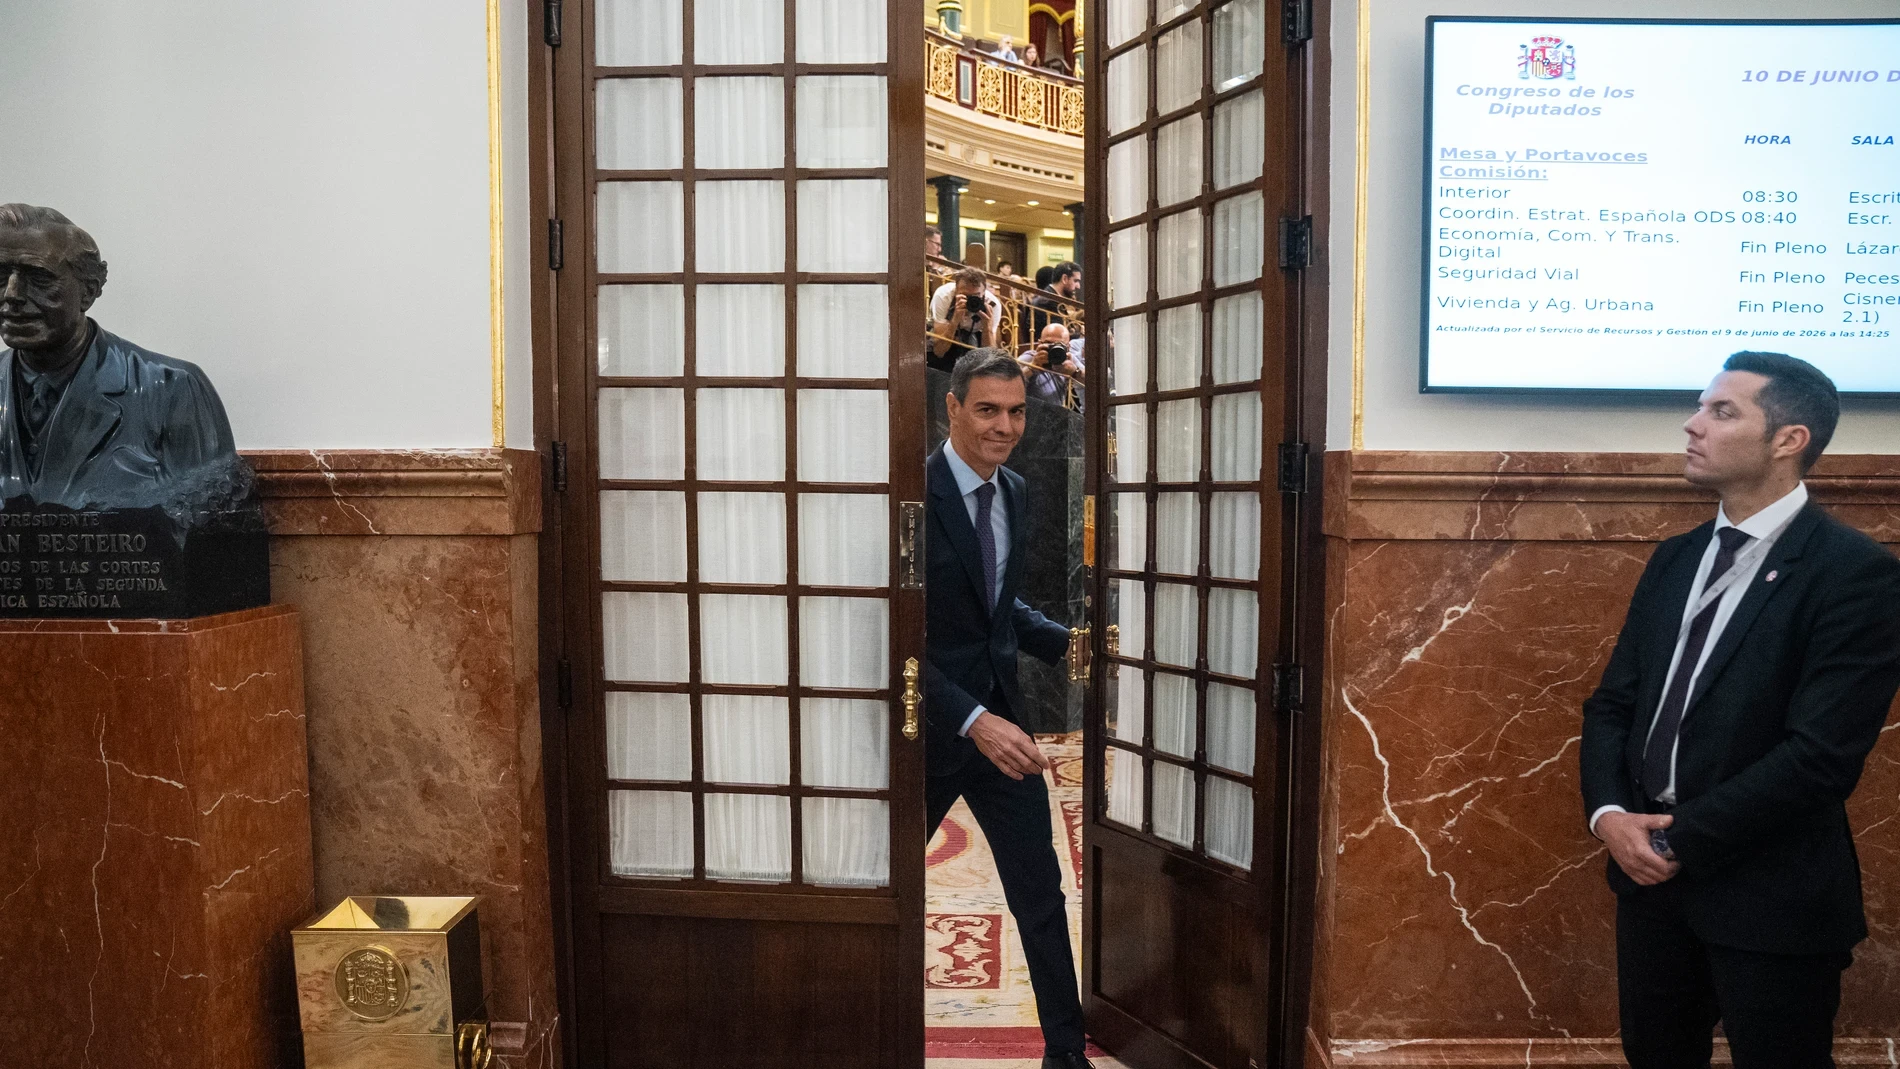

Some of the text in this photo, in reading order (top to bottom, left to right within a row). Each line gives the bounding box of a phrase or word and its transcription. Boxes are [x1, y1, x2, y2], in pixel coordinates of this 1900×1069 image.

[1742, 70, 1768, 82] 10
[1776, 71, 1806, 82] DE
[1810, 70, 1879, 85] JUNIO
[1455, 84, 1634, 100] Congreso de los
[1489, 103, 1602, 118] Diputados
[1745, 135, 1790, 144] HORA
[1852, 136, 1894, 145] SALA
[1439, 147, 1649, 163] Mesa y Portavoces
[1439, 165, 1548, 181] Comisión:
[1440, 186, 1510, 198] Interior
[1743, 191, 1797, 203] 08:30
[1439, 207, 1735, 224] Coordin. Estrat. Española ODS
[1742, 212, 1796, 224] 08:40
[1848, 213, 1891, 224] Escr.
[1439, 228, 1679, 243] Economía, Com. Y Trans.
[1439, 246, 1500, 261] Digital
[1741, 242, 1826, 254] Fin Pleno
[1846, 241, 1900, 254] Lázar
[1439, 267, 1578, 281] Seguridad Vial
[1740, 271, 1825, 283] Fin Pleno
[1845, 272, 1900, 284] Peces
[1437, 297, 1653, 313] Vivienda y Ag. Urbana
[1739, 301, 1823, 313] Fin Pleno
[1843, 311, 1879, 324] 2.1)
[1435, 324, 1501, 333] Actualizada
[1502, 327, 1524, 336] por
[1539, 326, 1584, 334] Servicio
[1603, 327, 1653, 335] Recursos
[1734, 329, 1749, 337] de
[1750, 329, 1780, 338] junio
[1782, 329, 1796, 337] de
[1799, 329, 1827, 337] 2026
[1839, 330, 1856, 338] las
[1859, 330, 1890, 338] 14:25
[38, 533, 147, 553] BESTEIRO
[30, 561, 50, 573] DE
[59, 561, 90, 574] LAS
[99, 561, 161, 574] CORTES
[35, 577, 54, 591] DE
[65, 577, 86, 591] LA
[96, 578, 167, 592] SEGUNDA
[38, 590, 121, 608] ESPAÑOLA
